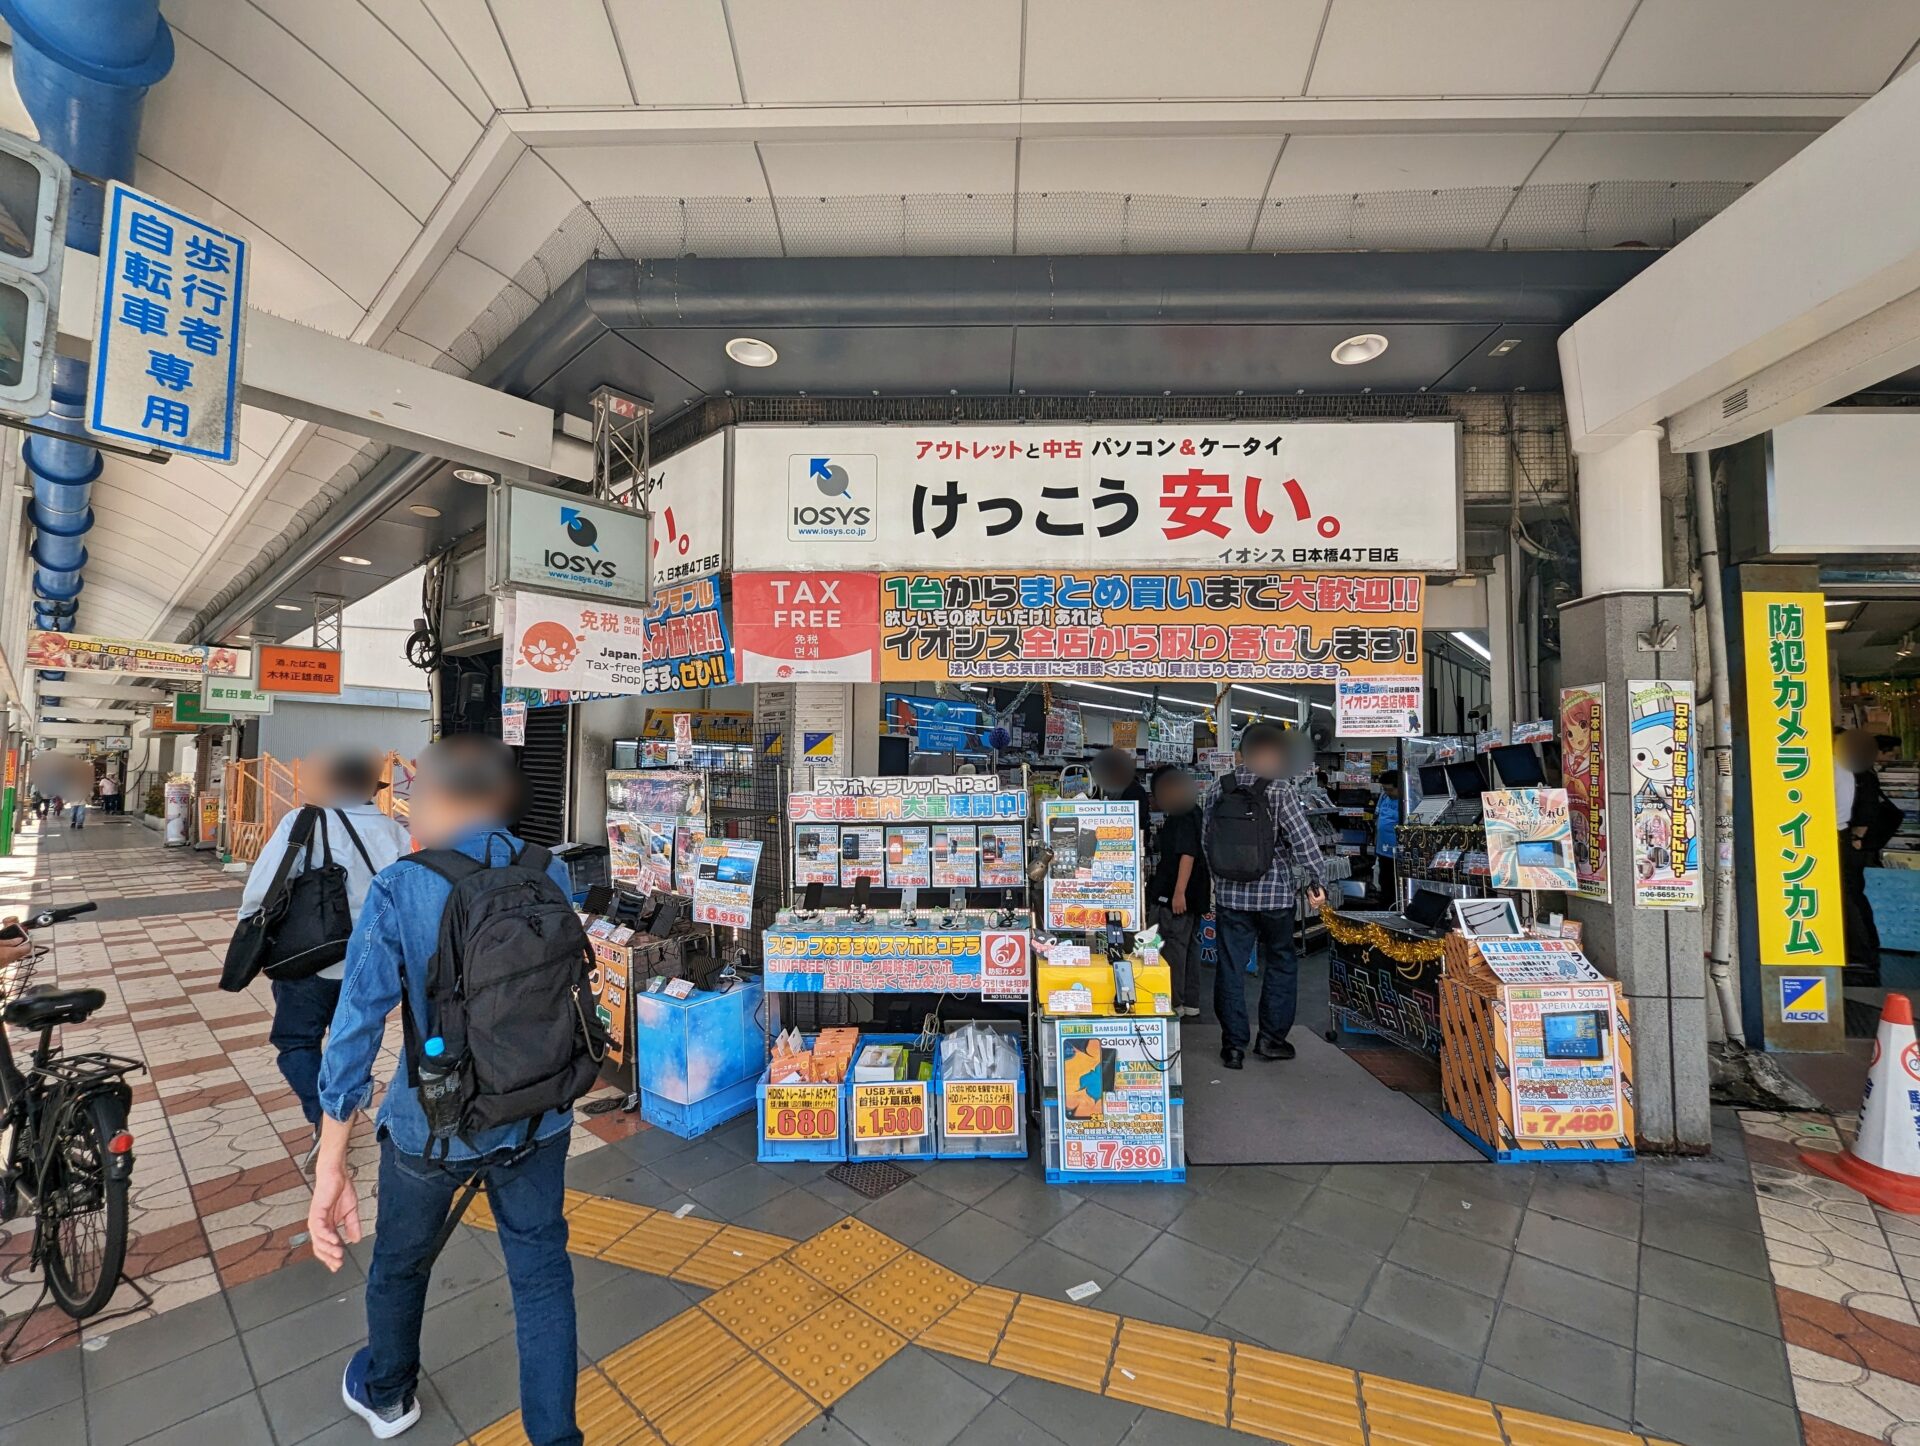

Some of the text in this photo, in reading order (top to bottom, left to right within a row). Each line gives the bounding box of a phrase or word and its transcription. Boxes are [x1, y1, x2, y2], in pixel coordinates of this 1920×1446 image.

[119, 210, 175, 338] 自転車
[178, 235, 231, 357] 歩行者
[141, 349, 194, 442] 専用
[915, 436, 1283, 460] アウトレットと中古 パソコン&ケータイ
[793, 507, 871, 526] IOSYS
[798, 527, 867, 537] www.iosys.co.jp
[545, 549, 617, 578] IOSYS
[1218, 548, 1399, 564] イオシス 日本橋4丁目店
[549, 571, 614, 588] www.iosys.co.jp
[770, 580, 841, 605] TAX
[885, 575, 1419, 613] 1台からまとめ買いまで大歓迎!!
[580, 610, 620, 634] 免税
[774, 609, 841, 628] FREE
[795, 634, 819, 645] 免税
[884, 625, 1418, 664] イオシス全店から取り寄せします!
[600, 647, 641, 661] Japan.
[795, 646, 819, 659] 면세
[586, 659, 641, 675] Tax-free
[611, 673, 641, 686] Shop
[1768, 604, 1824, 956] 防犯カメラ・インカム
[788, 792, 1028, 820] デモ機店内大量展開中!
[1116, 817, 1132, 825] Ace
[1646, 891, 1694, 899] 06-6655-1717
[766, 936, 982, 957] スタッフおすすめスマホはコチラ
[1577, 989, 1604, 997] SOT31
[1541, 1002, 1577, 1010] XPERIA
[1785, 1012, 1825, 1021] ALSOK
[1134, 1024, 1160, 1032] SCV43
[1100, 1036, 1159, 1047] Galaxy A30
[865, 1088, 886, 1096] USB
[858, 1095, 922, 1106] 首掛け扇風機
[1526, 1113, 1613, 1136] ¥7,480
